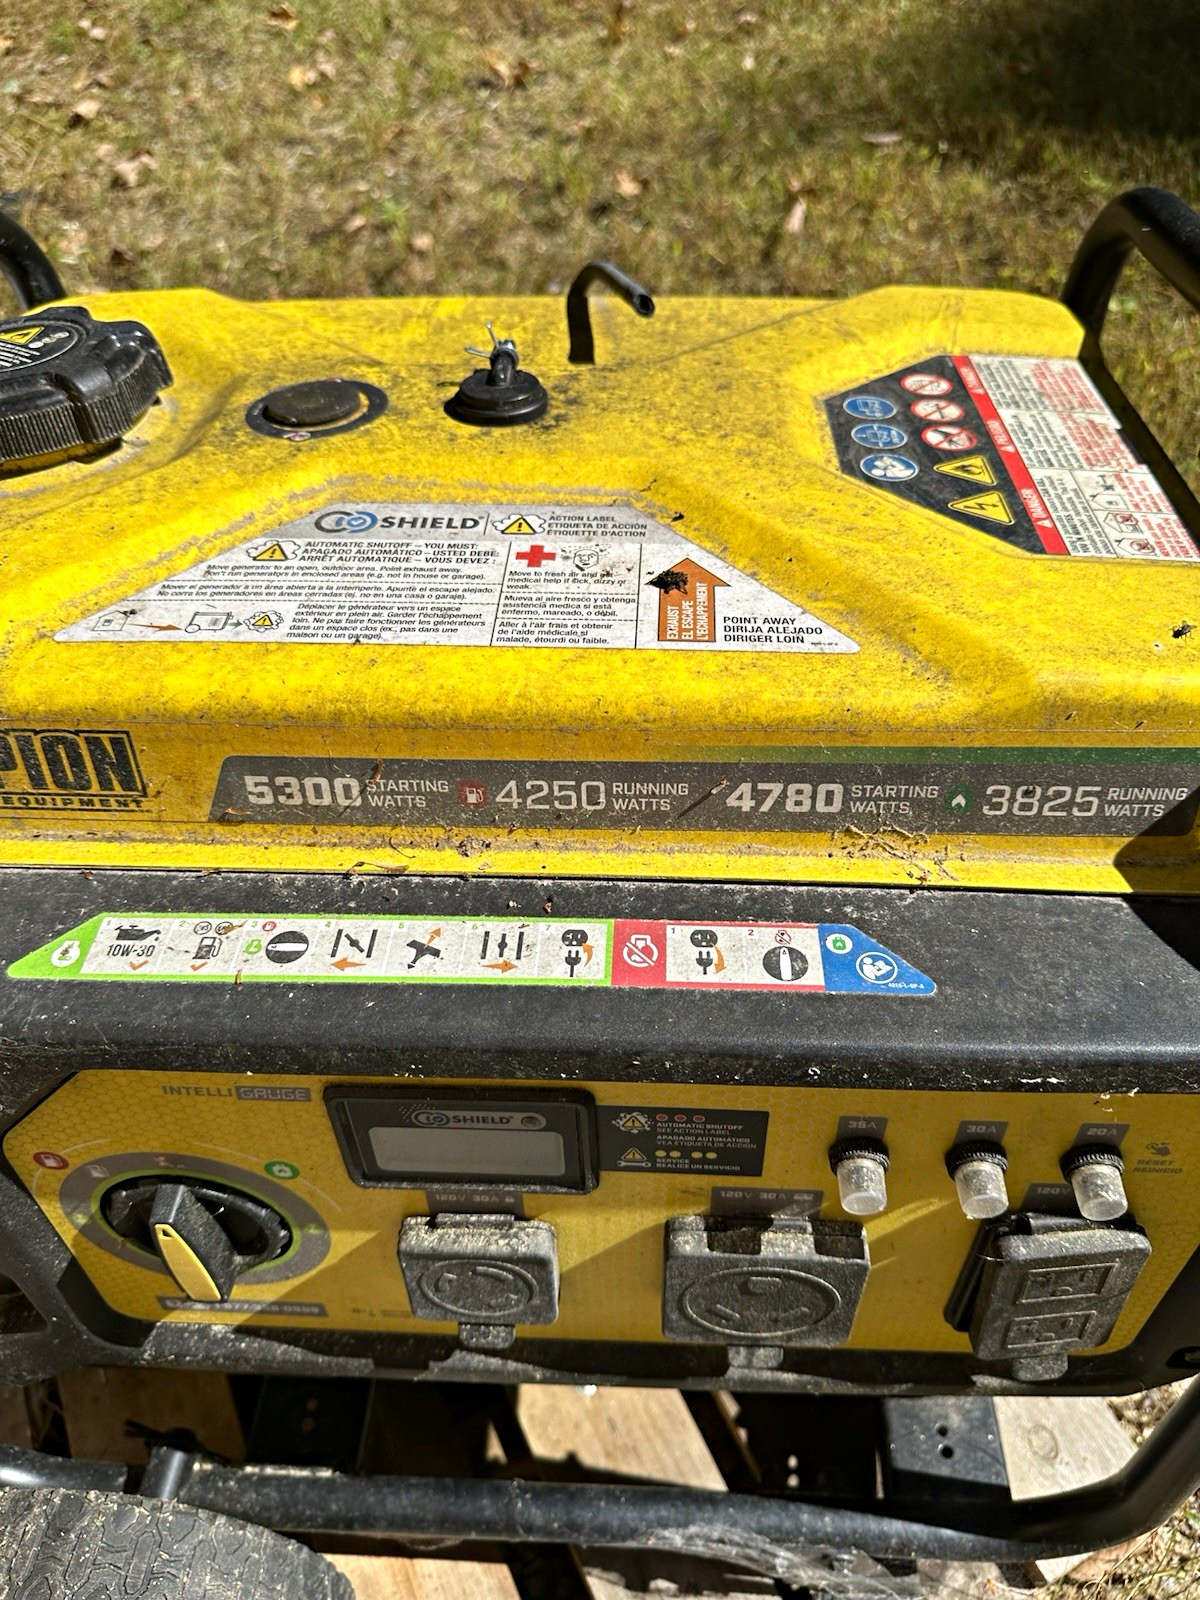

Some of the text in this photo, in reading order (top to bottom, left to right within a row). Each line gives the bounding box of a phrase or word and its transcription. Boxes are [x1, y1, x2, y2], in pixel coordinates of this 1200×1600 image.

[1021, 488, 1047, 521] DANGER
[611, 522, 647, 530] ACCIÓN
[355, 548, 422, 556] AUTOMÁTICO
[299, 554, 333, 562] ARRÊT
[337, 555, 411, 563] AUTOMATIQUE
[297, 603, 335, 611] Déplacer
[543, 609, 584, 617] mareado,
[667, 605, 680, 639] EXHAUST
[682, 600, 693, 640] EL ESCAPE
[723, 616, 797, 625] POINT AWAY
[581, 622, 613, 630] obtenir
[723, 625, 823, 635] DIRIJA ALEJADO
[537, 629, 578, 637] médicale
[723, 634, 805, 643] DIRIGER LOIN
[496, 636, 532, 644] malade,
[534, 636, 567, 644] étourdi
[244, 775, 449, 807] 5300 STARTING
[495, 780, 688, 810] 4250 RUNNING
[2, 796, 143, 808] EQUIPMENT
[366, 794, 426, 808] WATTS
[726, 782, 938, 813] 4780 STARTING
[982, 785, 1188, 817] 3825 RUNNING
[613, 797, 670, 811] WATTS
[850, 801, 911, 814] WATTS
[1104, 804, 1165, 817] WATTS
[106, 943, 155, 957] 10W-30
[162, 1085, 307, 1100] INTELLI GAUGE
[967, 1124, 996, 1134] 30A
[1087, 1127, 1117, 1136] 20A
[1137, 1158, 1174, 1166] RESET
